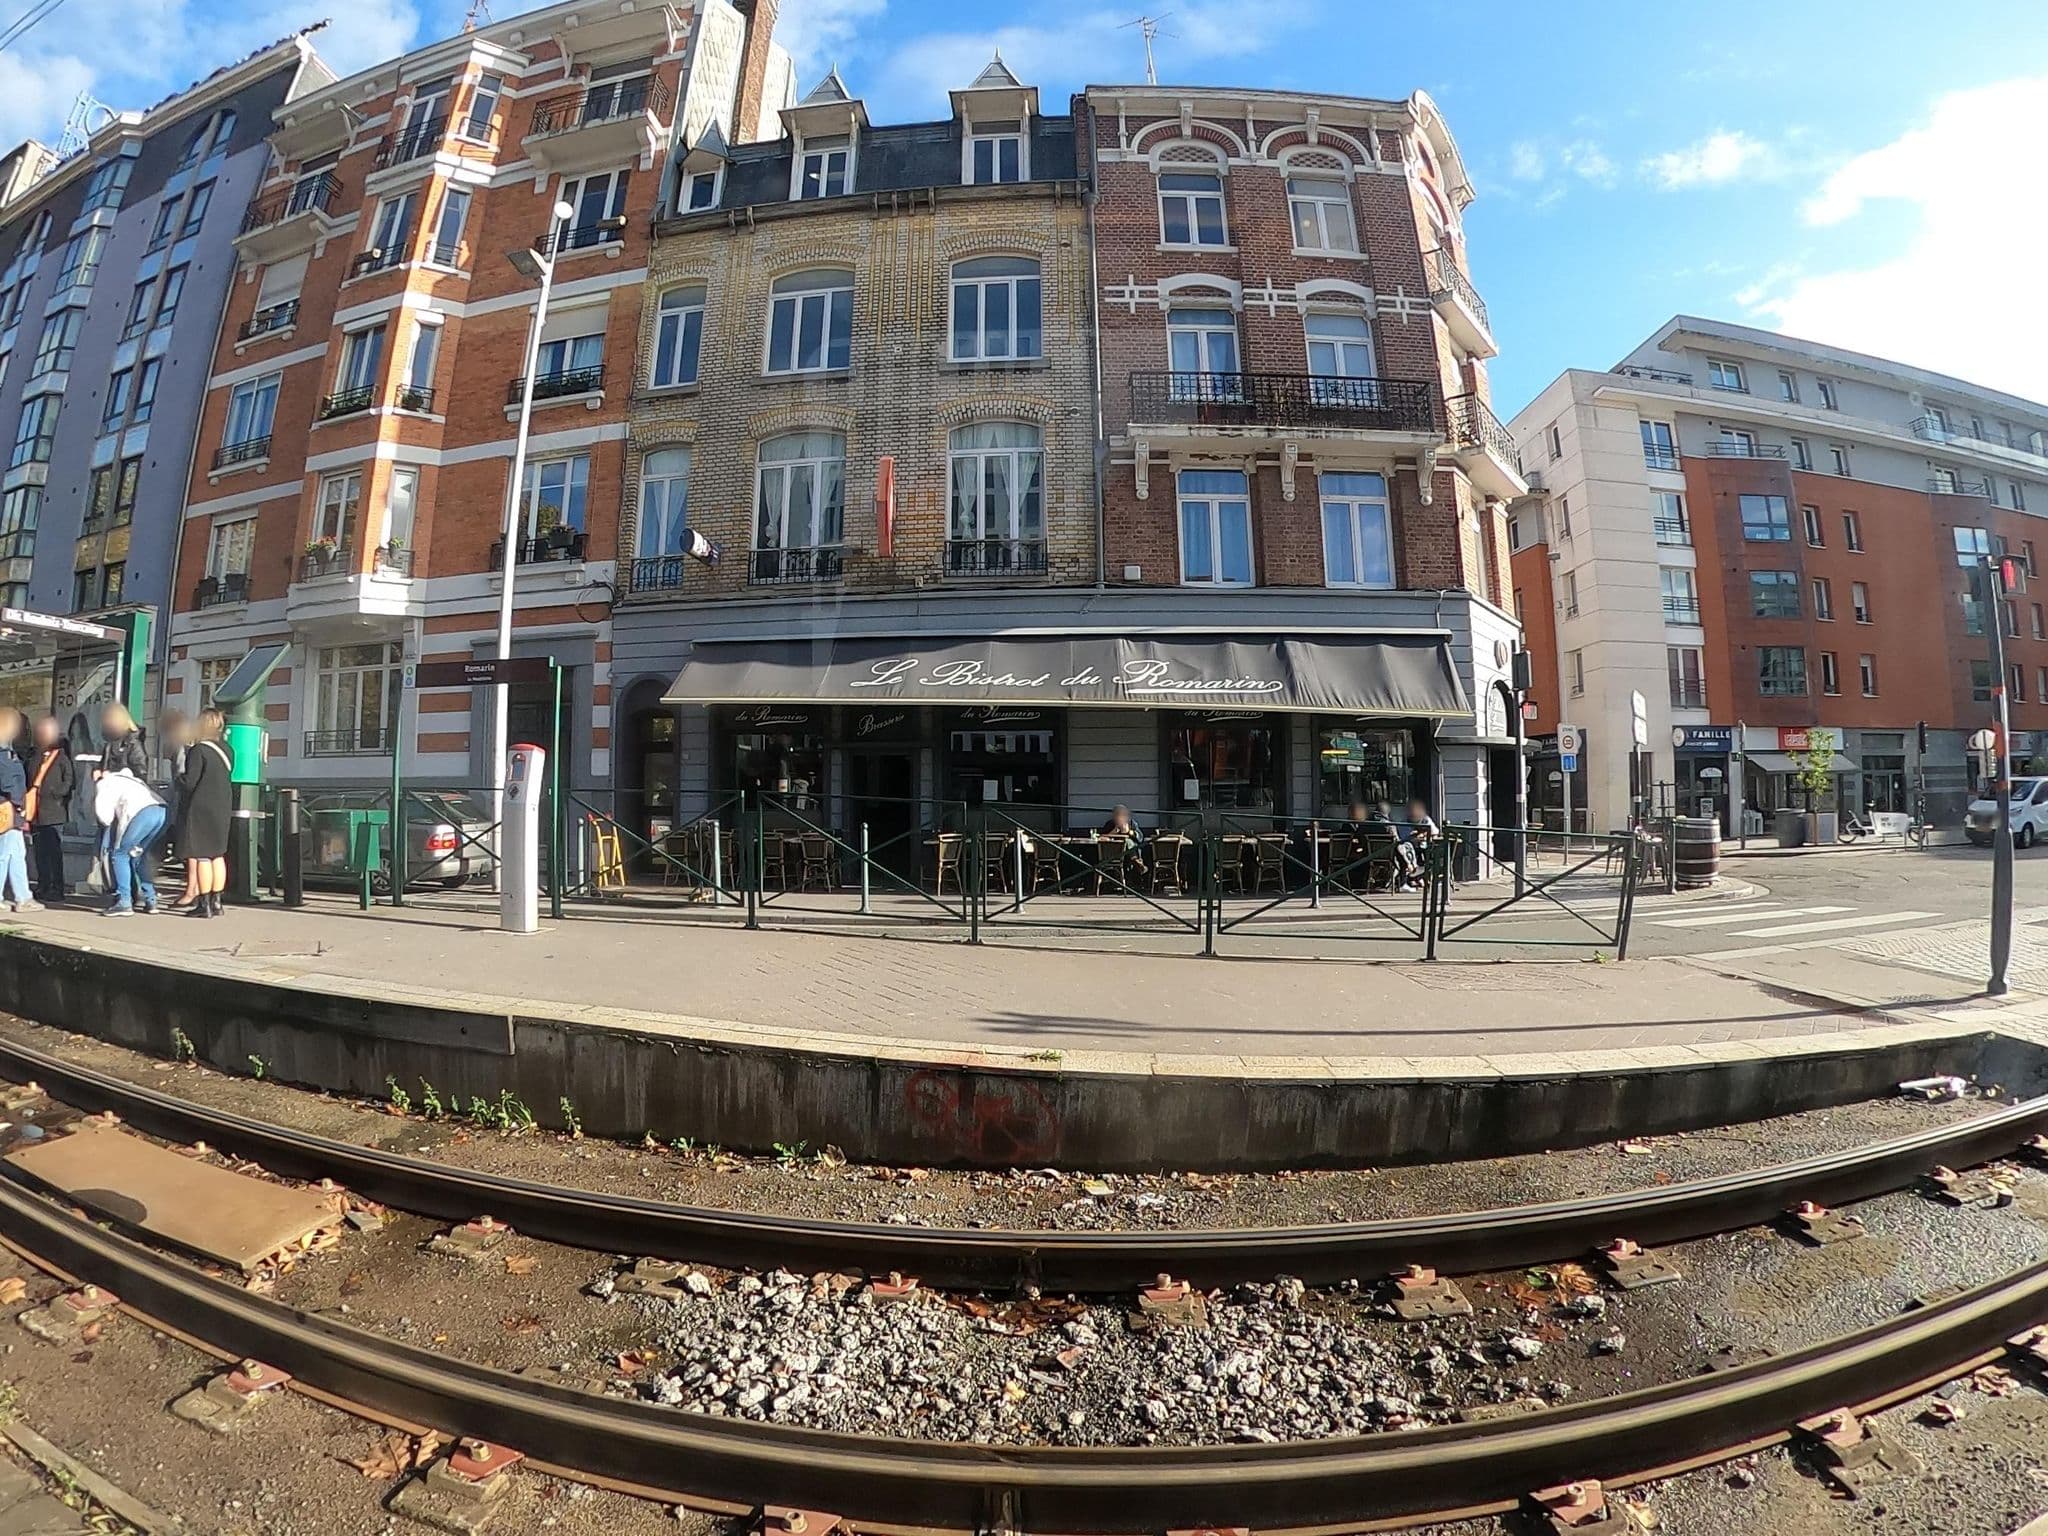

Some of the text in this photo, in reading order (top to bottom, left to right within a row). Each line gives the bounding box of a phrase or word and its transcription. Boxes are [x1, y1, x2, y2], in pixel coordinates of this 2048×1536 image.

[850, 658, 1283, 694] Le Bistrot du Romarin
[752, 705, 808, 726] Romarin
[979, 704, 1041, 723] Romarin
